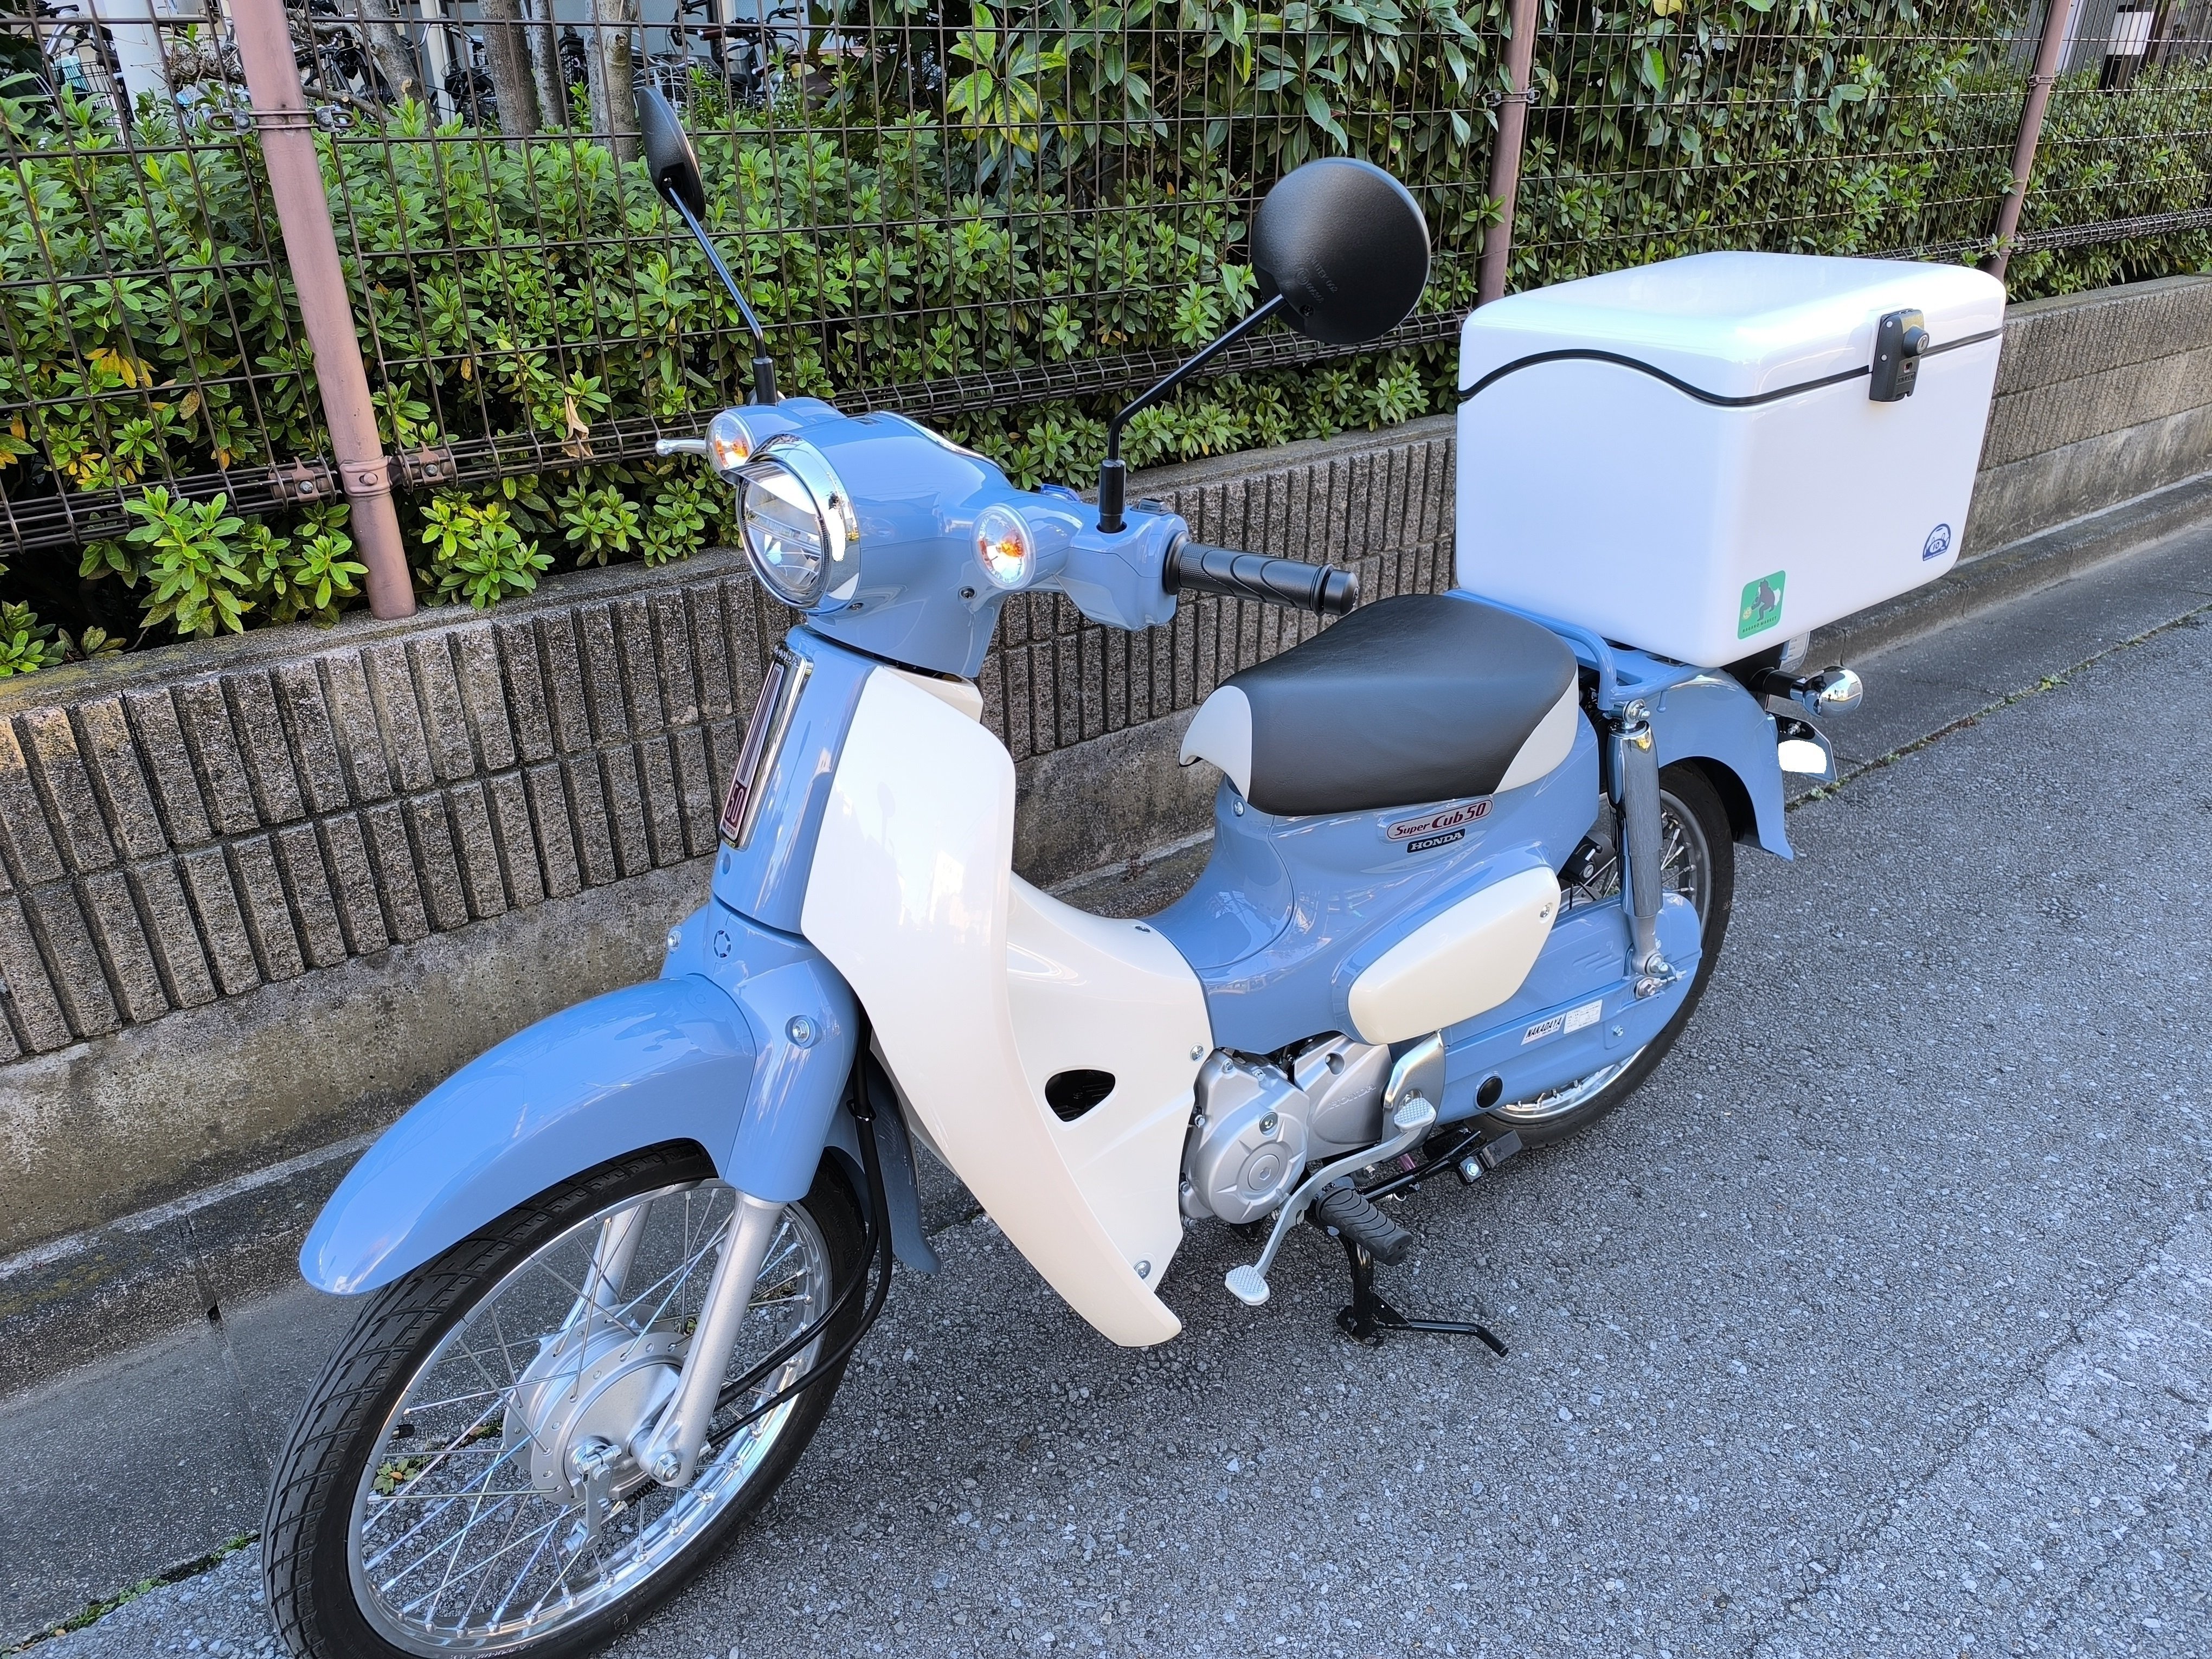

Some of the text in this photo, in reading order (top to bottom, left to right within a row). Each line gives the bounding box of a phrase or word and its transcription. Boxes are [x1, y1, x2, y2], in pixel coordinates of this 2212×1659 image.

[1760, 616, 1777, 626] MARKET
[1394, 802, 1487, 836] Super Cub 50
[1410, 831, 1463, 851] HONDA
[1526, 1017, 1562, 1039] NAKADAYA
[1328, 1084, 1376, 1109] HONDA
